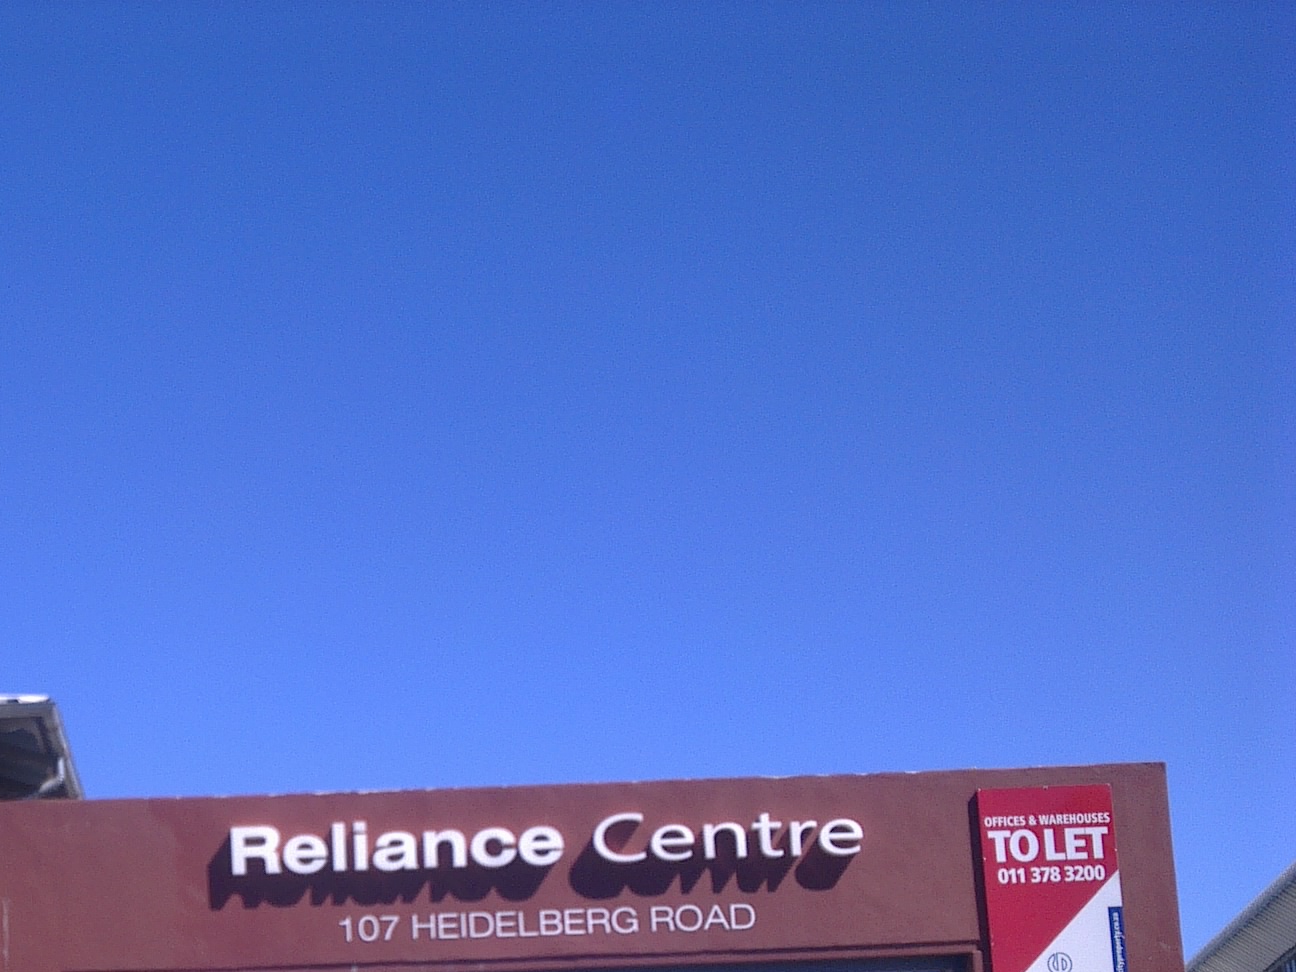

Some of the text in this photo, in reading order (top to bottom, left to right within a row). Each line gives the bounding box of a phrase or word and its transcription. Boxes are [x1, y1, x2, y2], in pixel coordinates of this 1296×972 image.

[984, 812, 1111, 828] OFFICES & WAREHOUSES
[229, 812, 864, 876] Reliance Centre
[987, 826, 1109, 863] TO LET
[997, 864, 1106, 884] 011 378 3200
[338, 903, 756, 943] 107 HEIDELBERG ROAD
